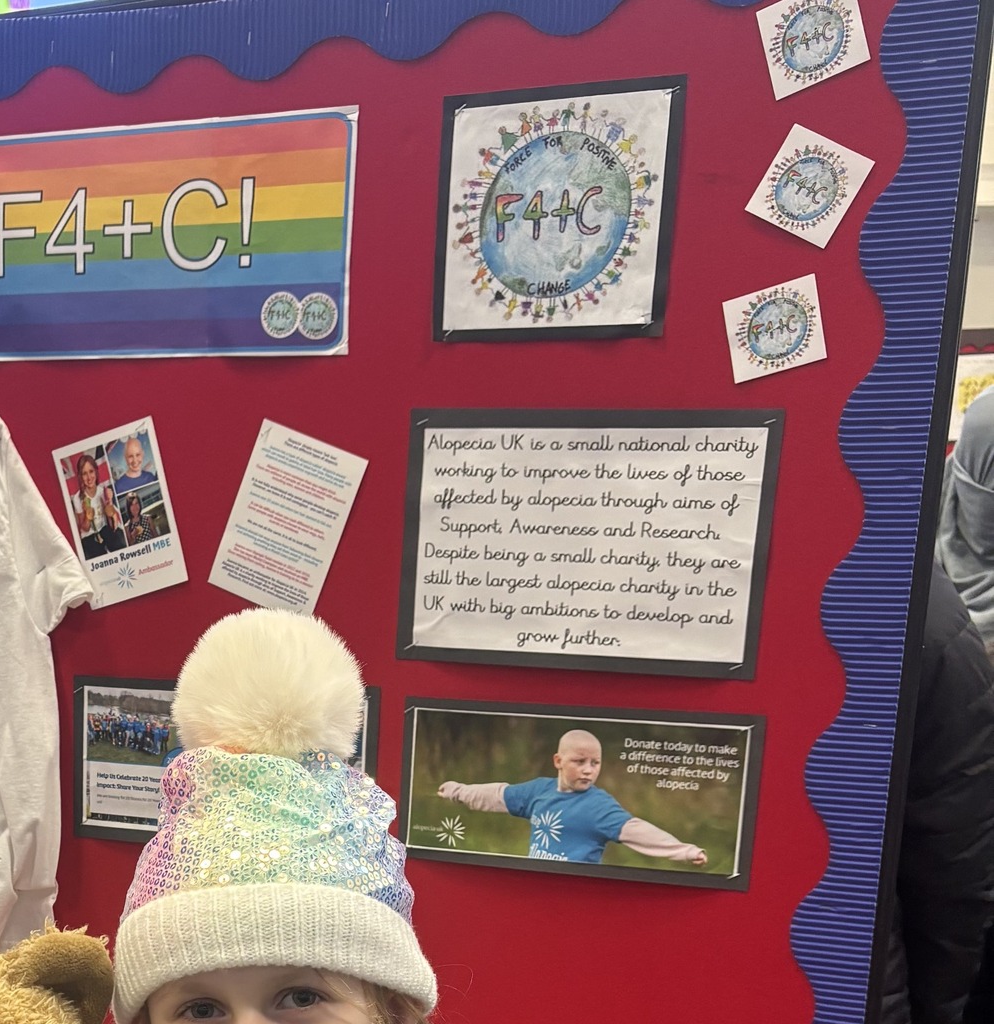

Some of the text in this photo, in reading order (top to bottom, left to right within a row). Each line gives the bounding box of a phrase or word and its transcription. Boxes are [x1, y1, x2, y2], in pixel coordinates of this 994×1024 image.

[506, 136, 617, 174] FORCE FOR POSITIVE
[495, 186, 603, 242] F4+C
[527, 279, 571, 296] CHANGE
[428, 434, 758, 458] Alopecia UK is a small national charity
[435, 462, 746, 486] working to improve the lives of those
[434, 488, 740, 516] affected by alopecia through aims of
[440, 516, 502, 538] Support,
[509, 519, 599, 536] Awareness
[604, 522, 636, 537] and
[91, 538, 171, 572] Joanna Rowsell MBE
[424, 542, 479, 564] Despite
[485, 545, 529, 567] being
[534, 552, 546, 561] a
[551, 548, 596, 564] small
[667, 552, 706, 574] they
[711, 558, 741, 569] are
[424, 570, 737, 601] still the largest alopecia charity in the
[424, 595, 733, 628] UK with big ambitions to develop and
[517, 628, 621, 649] grow further.
[620, 749, 740, 769] a difference to the lives
[625, 738, 738, 756] Donate today to make
[627, 763, 730, 782] of those affected by
[656, 778, 700, 791] alopecia
